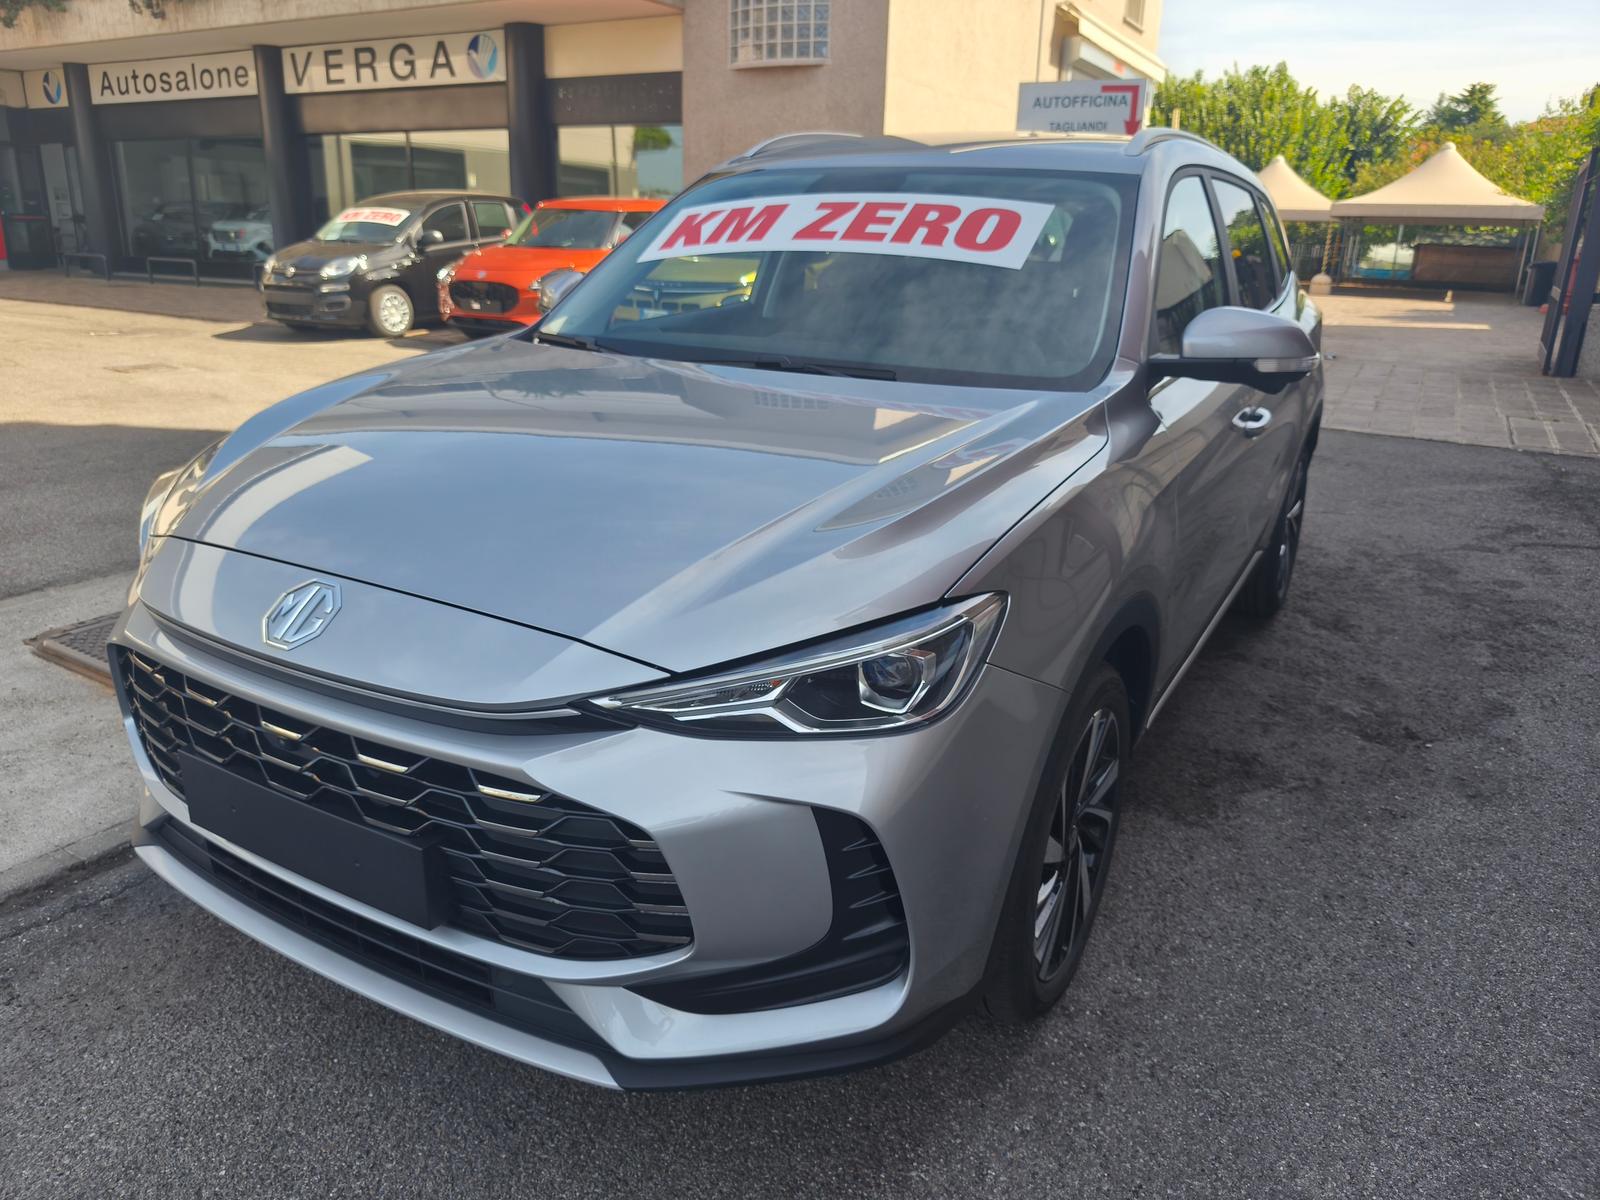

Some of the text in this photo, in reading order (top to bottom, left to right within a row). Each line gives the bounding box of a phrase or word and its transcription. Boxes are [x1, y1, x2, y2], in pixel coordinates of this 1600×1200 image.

[100, 40, 456, 97] Autosalone VERGA
[1032, 95, 1129, 109] AUTOFFICINA
[658, 201, 1022, 253] KM ZERO
[270, 584, 335, 644] MG
